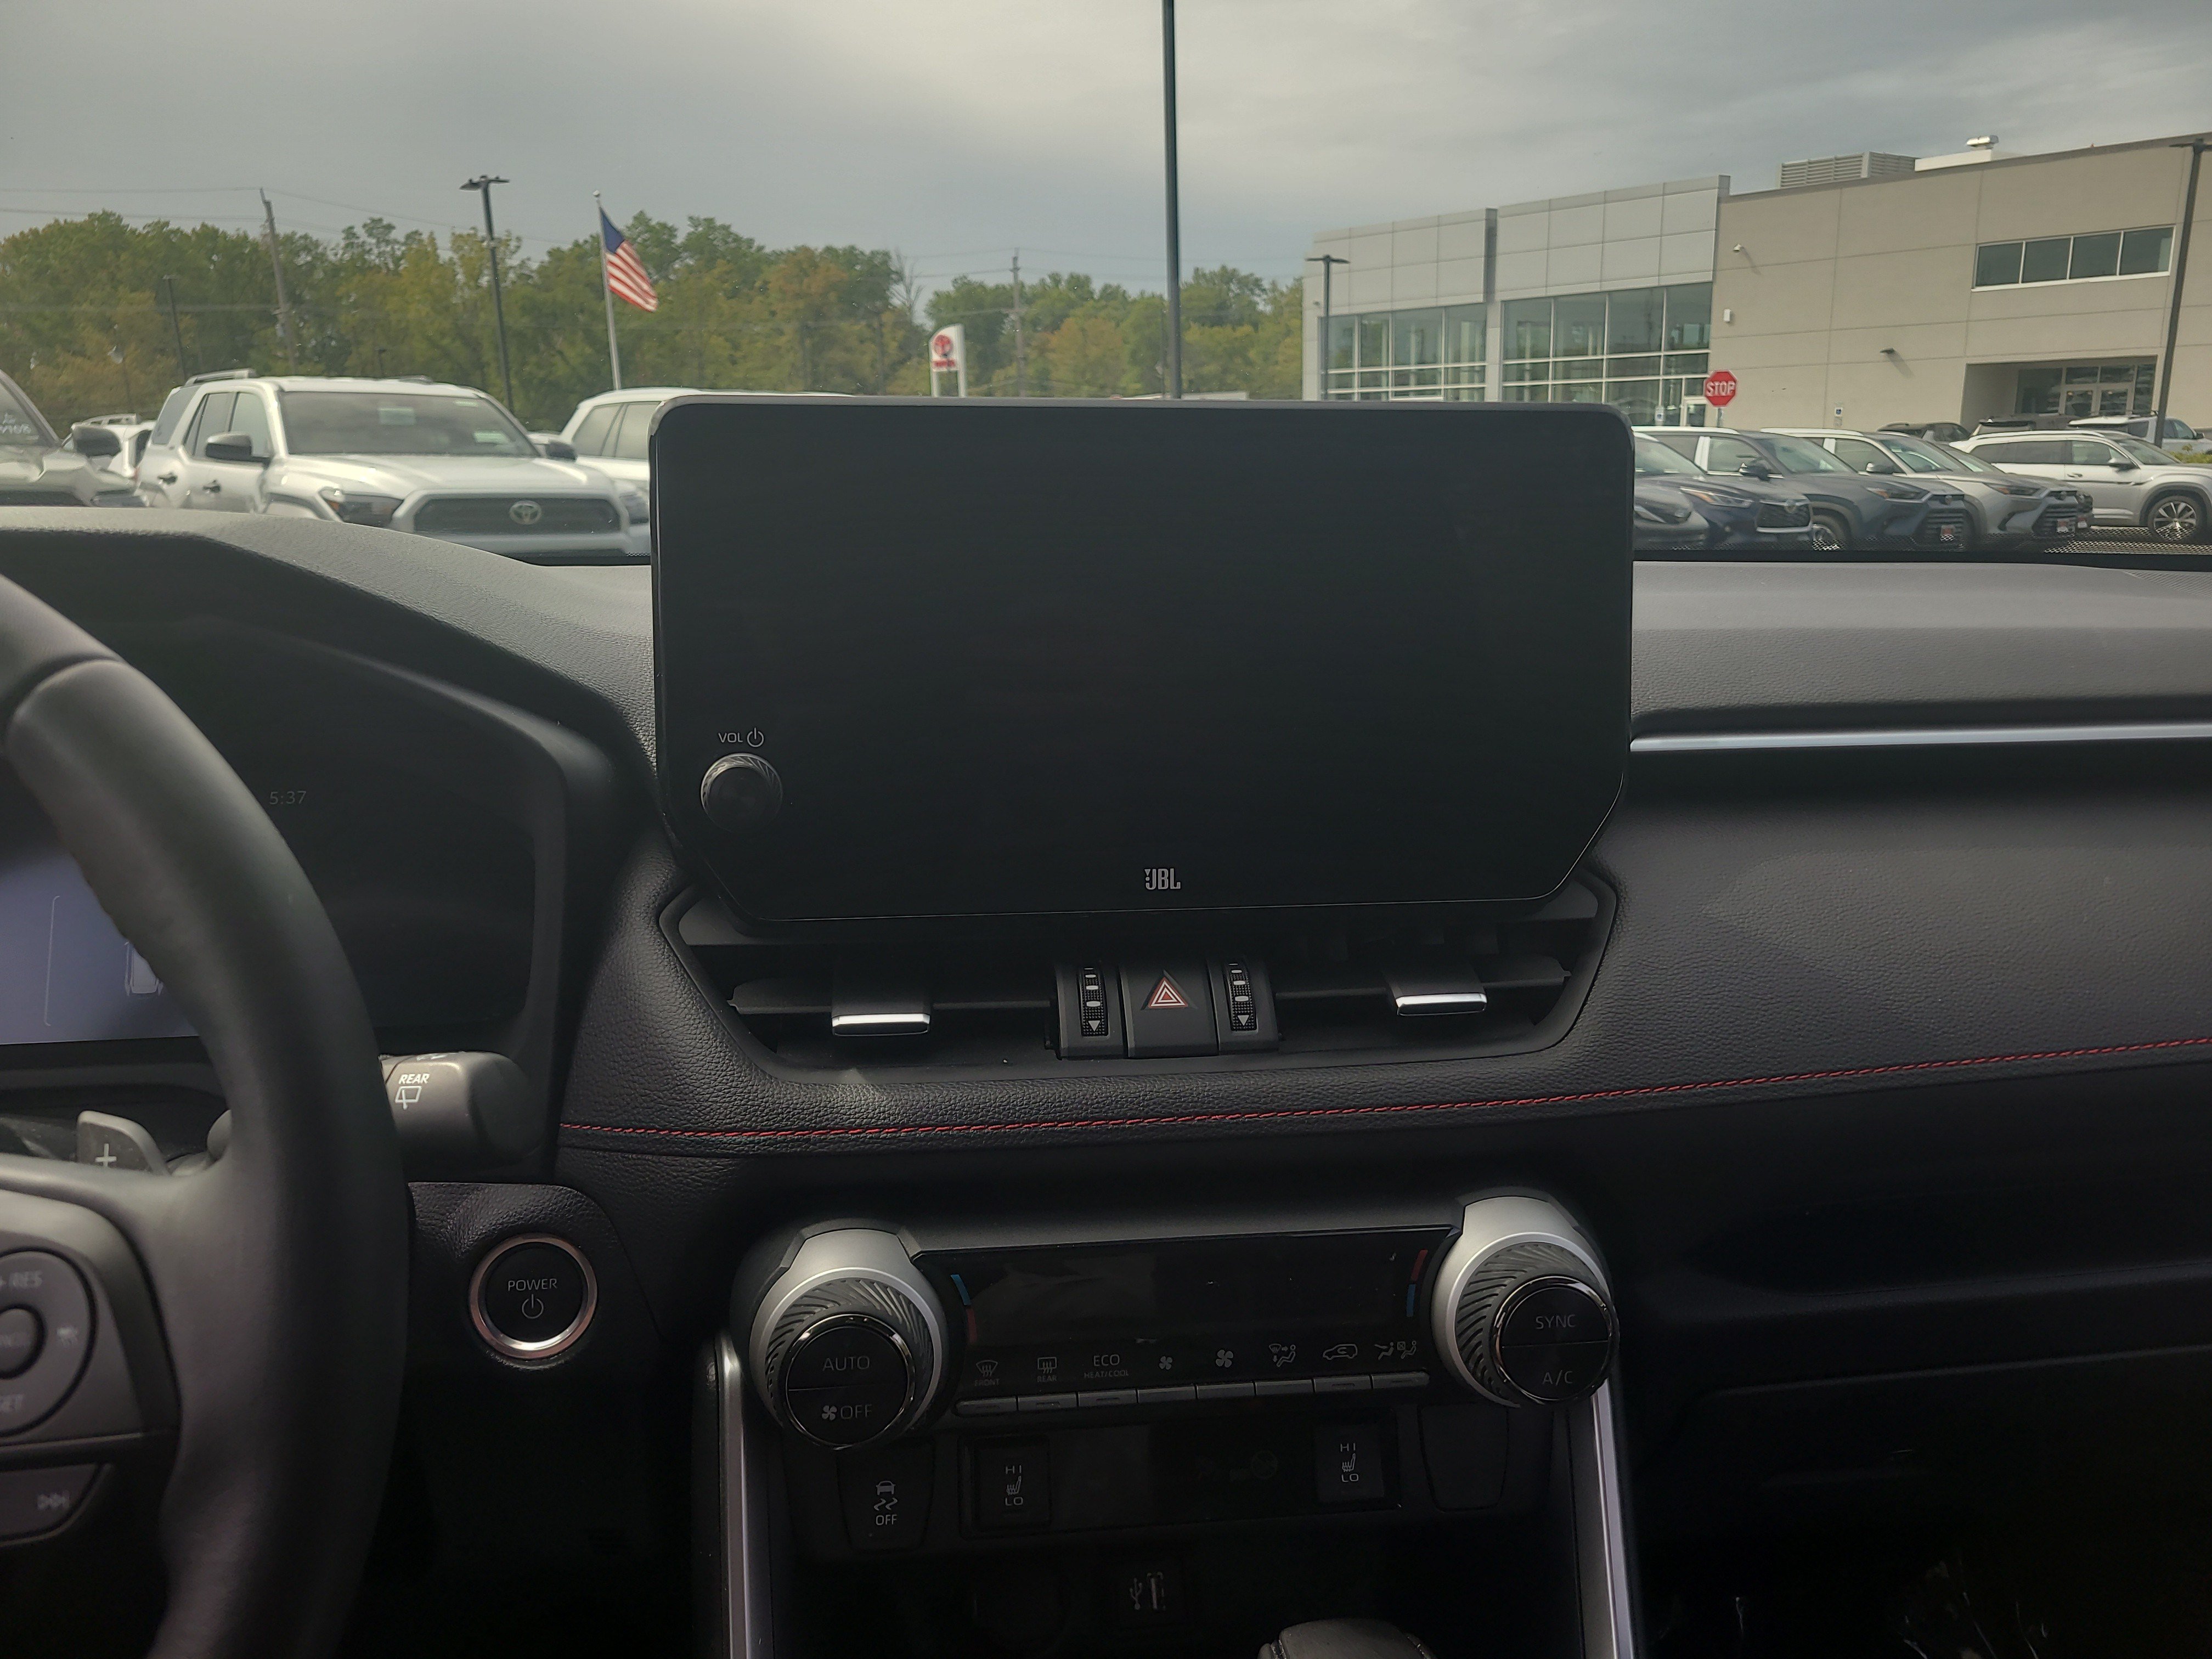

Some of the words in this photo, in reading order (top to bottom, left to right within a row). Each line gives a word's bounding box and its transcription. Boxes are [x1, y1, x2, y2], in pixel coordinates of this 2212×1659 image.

[1706, 380, 1736, 397] STOP
[718, 732, 743, 743] VOL
[269, 791, 307, 805] 5:37
[1144, 868, 1181, 890] JBL
[398, 1073, 430, 1084] REAR
[507, 1278, 558, 1291] POWER
[1536, 1314, 1576, 1329] SYNC
[822, 1356, 870, 1372] AUTO
[1093, 1354, 1120, 1367] ECO
[1084, 1370, 1129, 1379] HEAT/COOL
[1542, 1369, 1573, 1386] A/C
[974, 1378, 1000, 1387] FRONT
[840, 1403, 872, 1420] OFF
[1340, 1442, 1356, 1452] HI
[1005, 1465, 1022, 1475] HI
[1341, 1474, 1359, 1482] LO
[1005, 1497, 1024, 1506] LO
[876, 1514, 898, 1526] OFF
